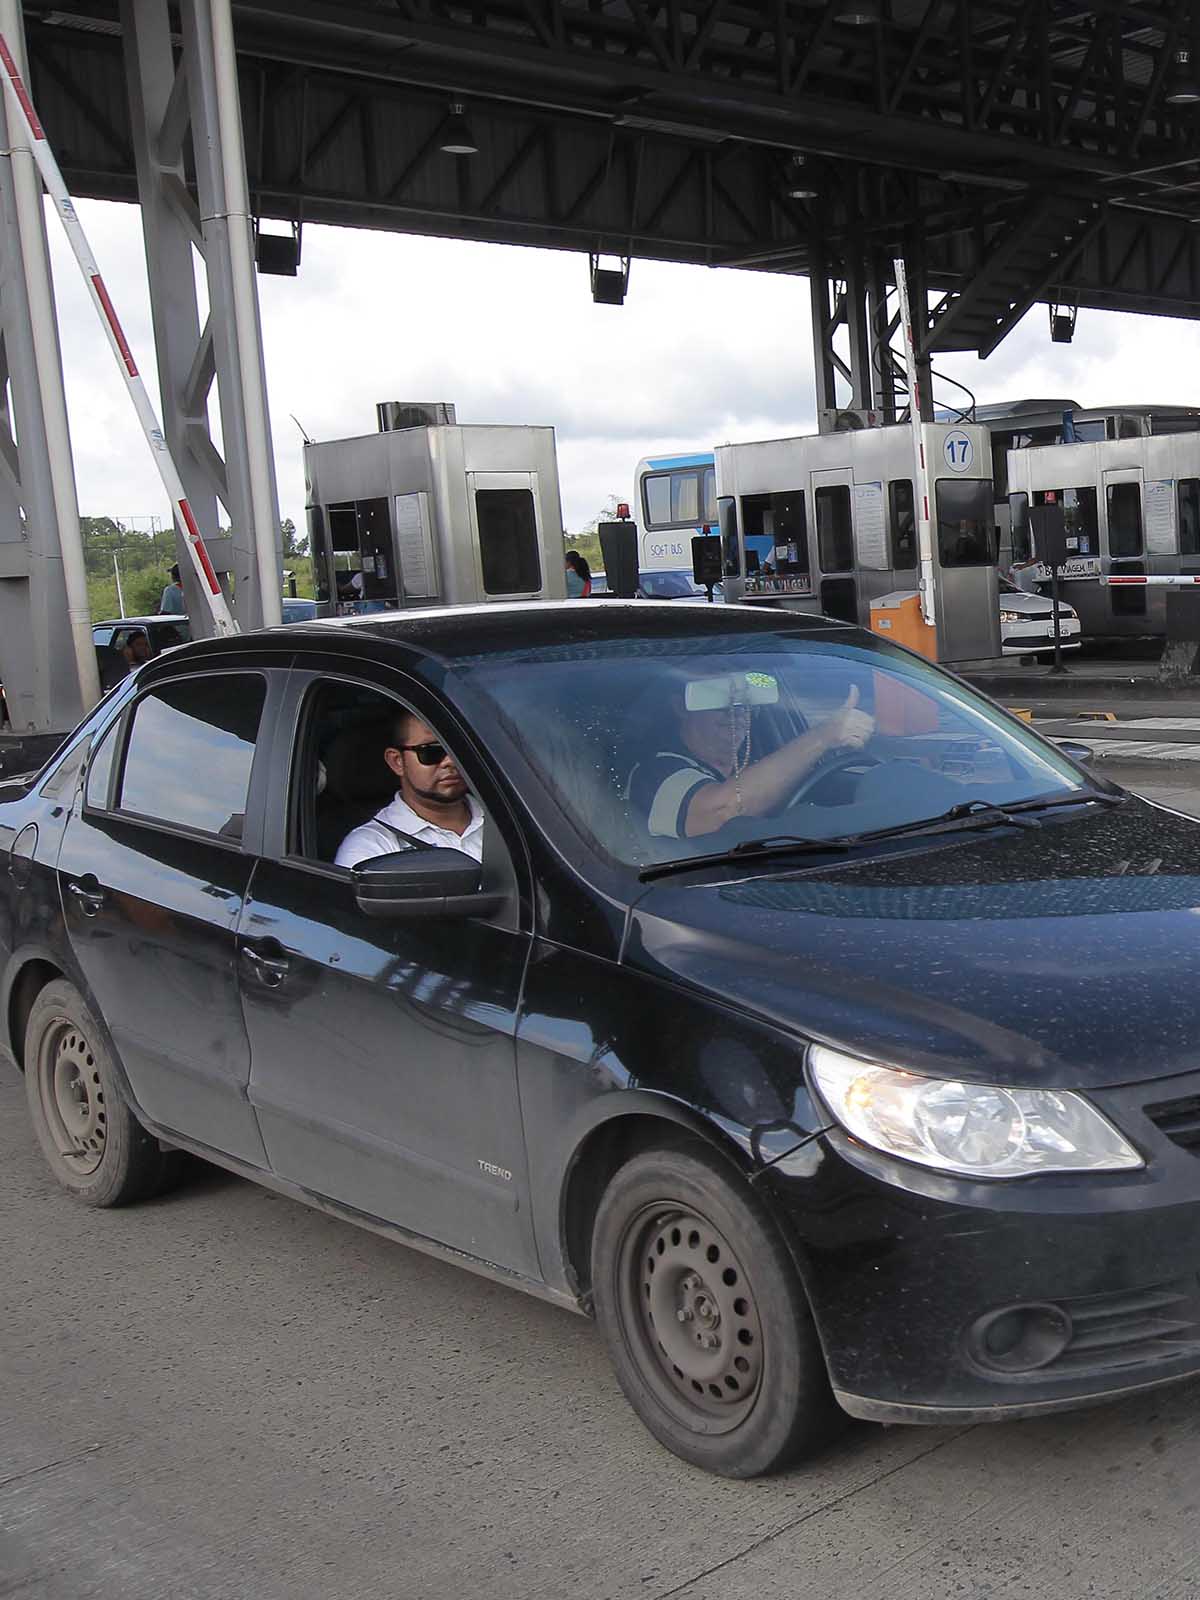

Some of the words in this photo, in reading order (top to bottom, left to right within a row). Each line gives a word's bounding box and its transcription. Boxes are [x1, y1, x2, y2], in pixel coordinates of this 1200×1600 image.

[947, 441, 968, 463] 17
[671, 543, 683, 555] BUS
[478, 1160, 512, 1180] TREND
